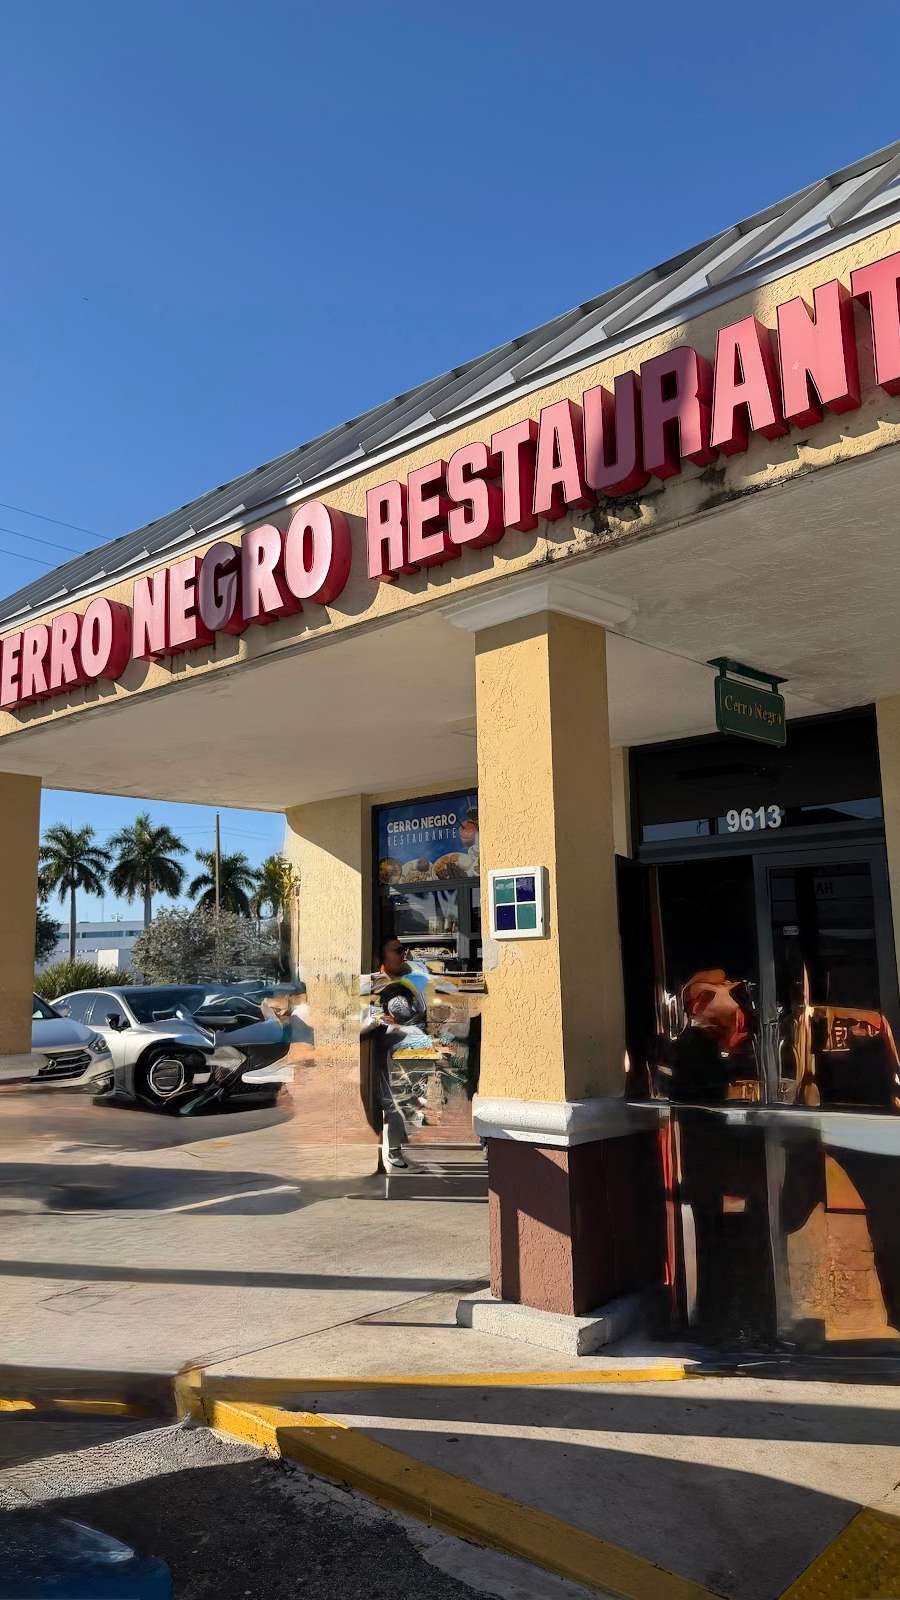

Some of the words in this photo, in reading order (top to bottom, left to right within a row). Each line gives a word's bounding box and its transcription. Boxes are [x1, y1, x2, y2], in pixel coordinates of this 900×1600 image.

[0, 597, 114, 707] ERRO
[132, 501, 334, 660] NEGRO
[366, 252, 900, 580] RESTAURANT
[725, 695, 753, 718] Cerro
[386, 819, 419, 834] CERRO
[420, 813, 457, 829] NEGRO
[726, 804, 782, 833] 9613
